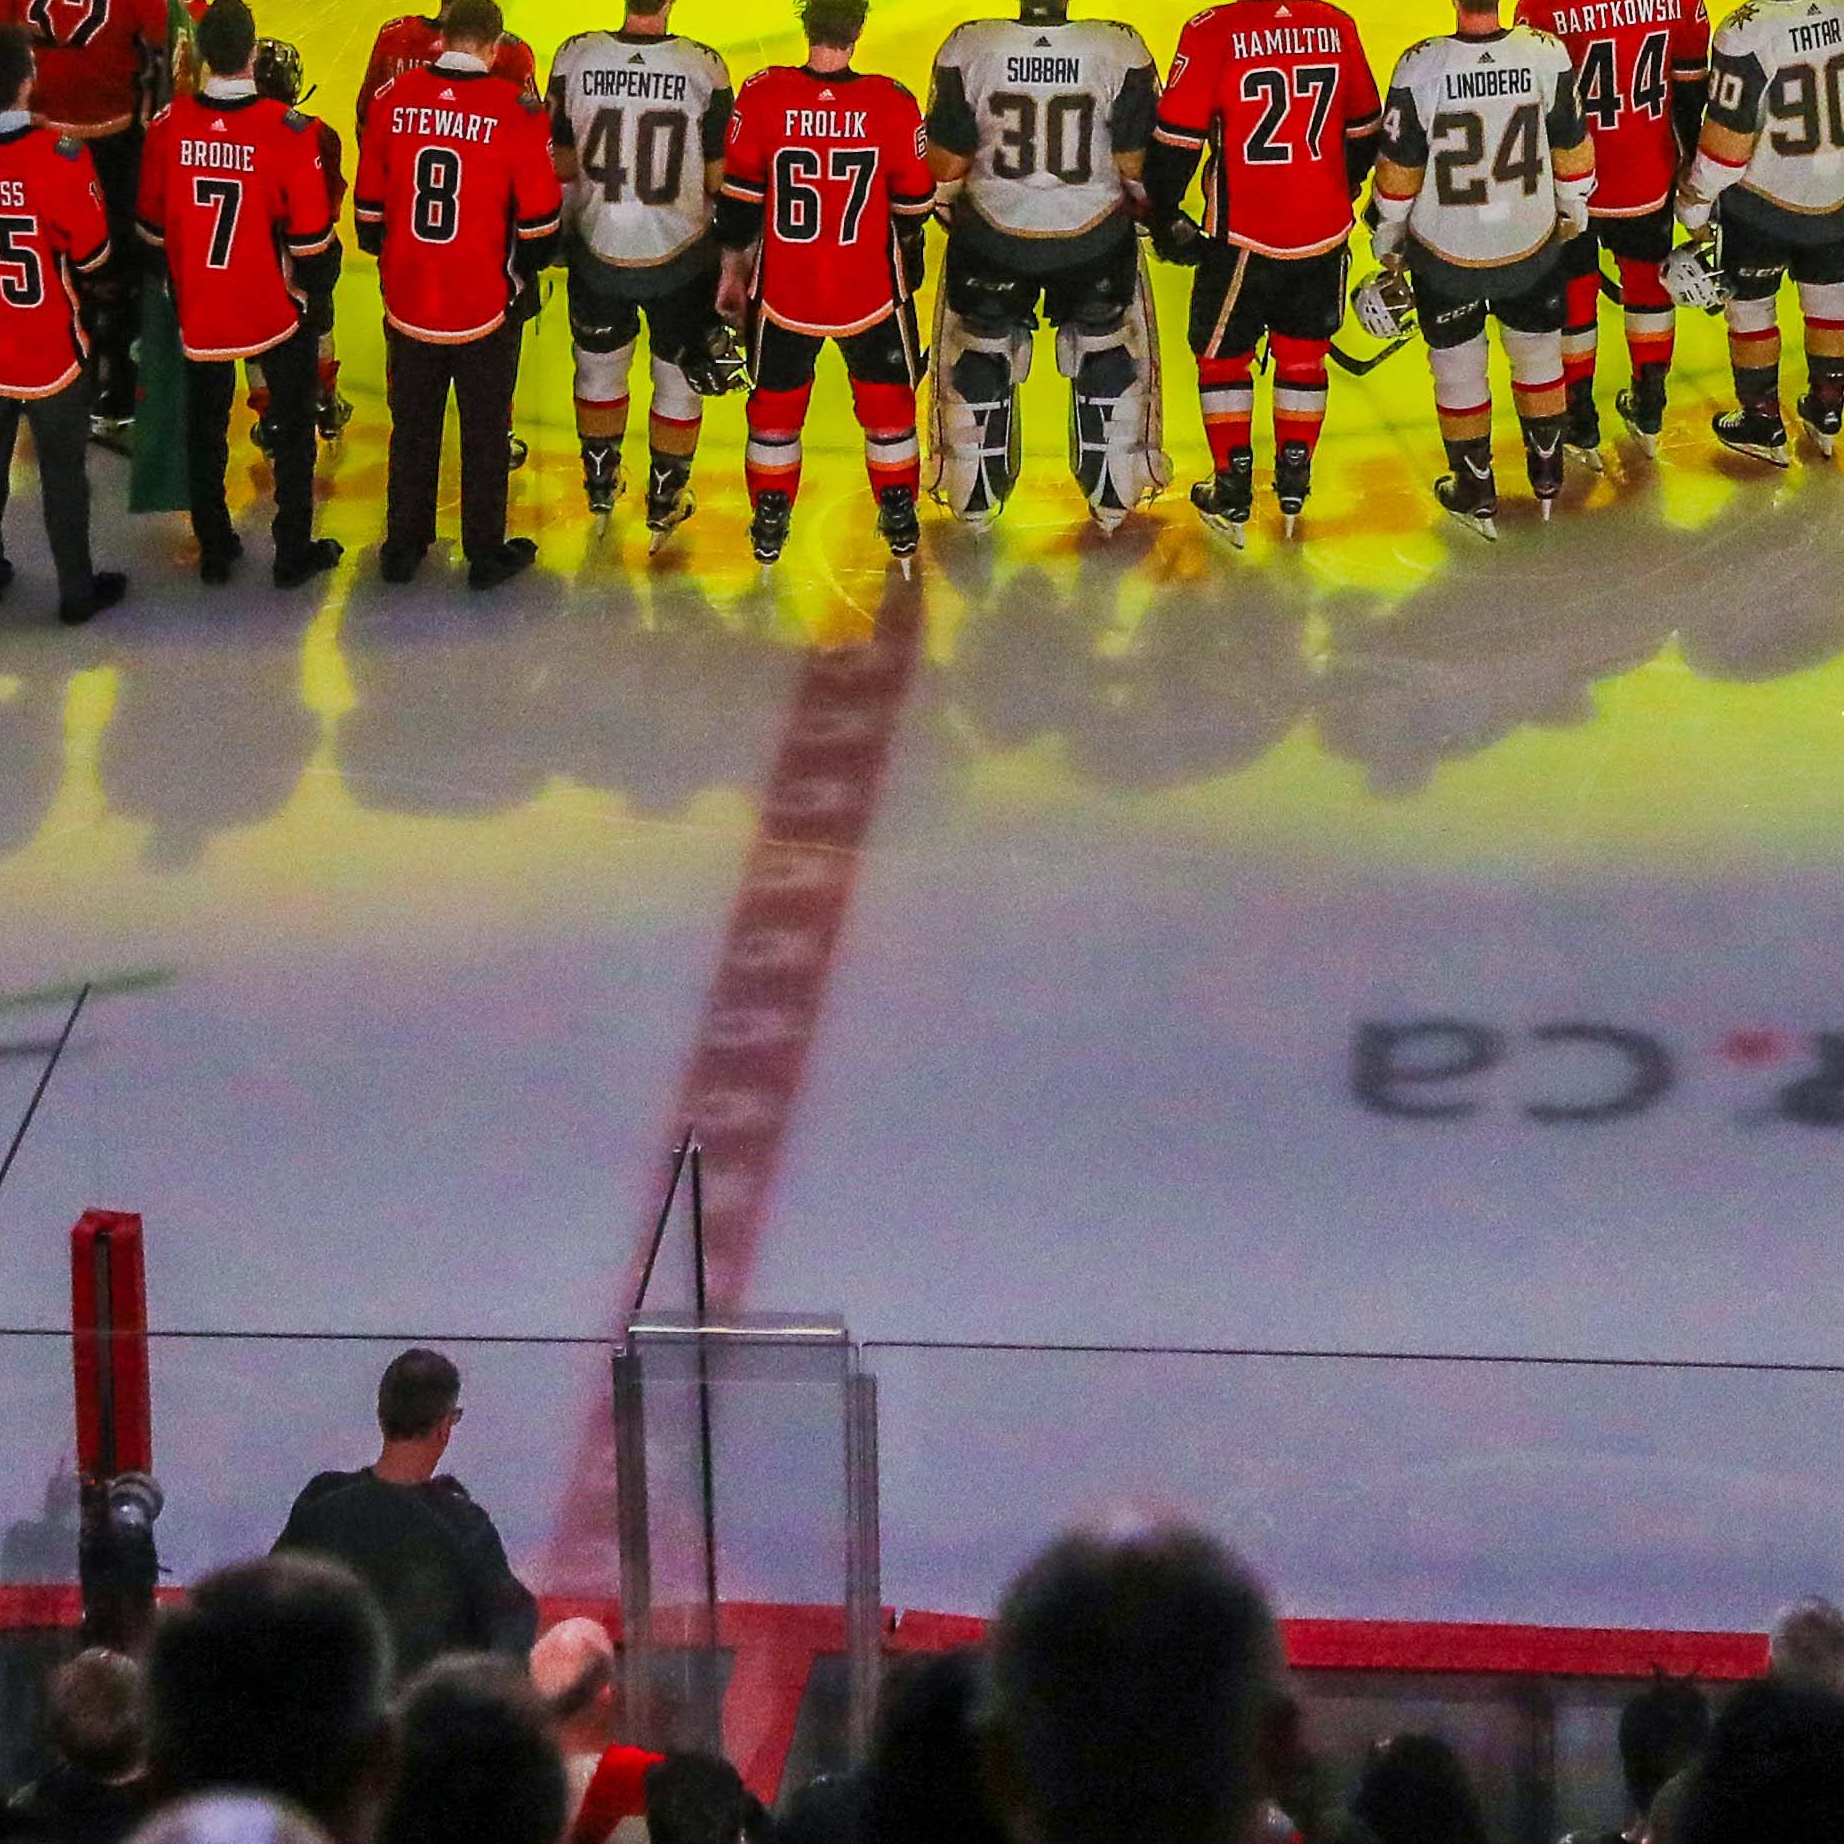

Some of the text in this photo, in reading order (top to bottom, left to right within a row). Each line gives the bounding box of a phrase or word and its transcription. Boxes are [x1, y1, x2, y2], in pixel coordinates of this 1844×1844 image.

[1231, 28, 1343, 61] HAMILTON
[1788, 17, 1843, 53] TATAR
[581, 69, 687, 102] CARPENTER
[1007, 56, 1080, 84] SUBBAN
[1446, 64, 1533, 102] LINDBERG
[1577, 29, 1671, 131] 44
[391, 107, 498, 144] STEWART
[784, 109, 869, 140] FROLIK
[989, 91, 1097, 186] 30
[1241, 62, 1341, 165] 27
[181, 139, 256, 172] BRODIE
[581, 106, 690, 206] 40
[1431, 104, 1547, 208] 24
[193, 176, 243, 270] 7
[411, 145, 462, 244] 8
[772, 145, 880, 247] 67
